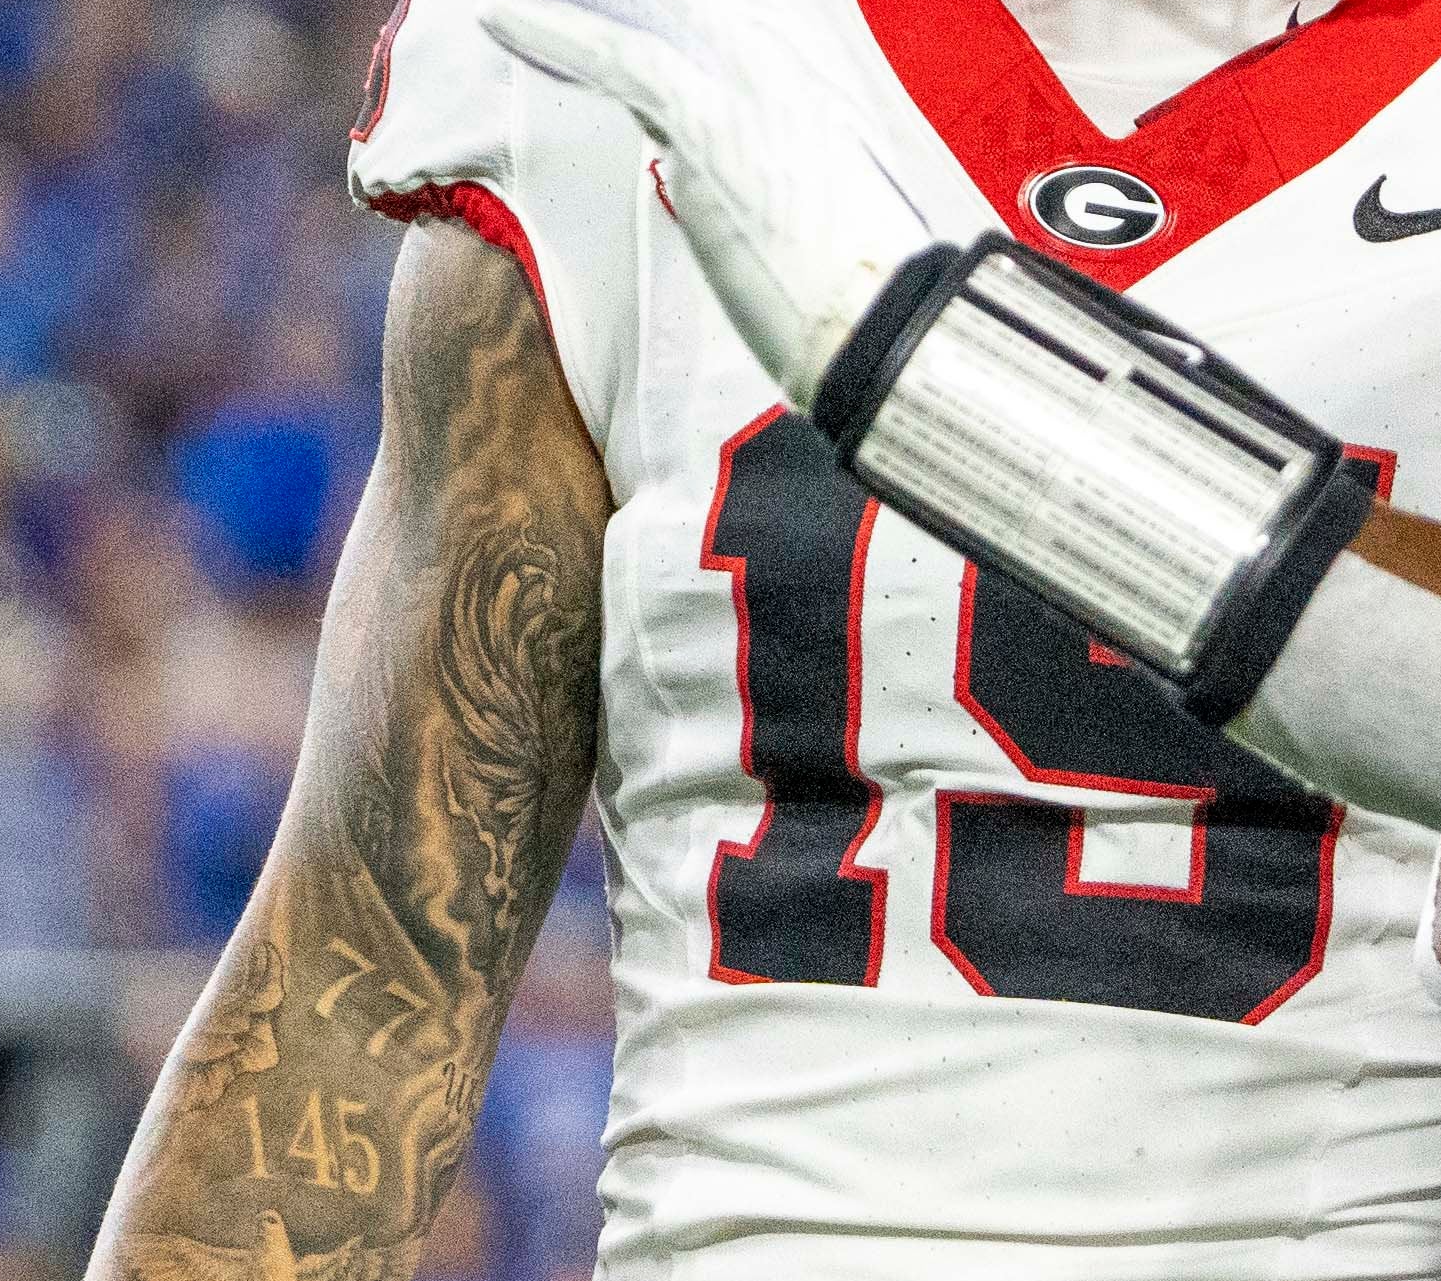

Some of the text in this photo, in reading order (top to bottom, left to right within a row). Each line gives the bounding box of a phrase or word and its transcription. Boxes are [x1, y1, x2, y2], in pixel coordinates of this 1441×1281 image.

[1031, 167, 1162, 246] G
[700, 402, 1398, 1026] 15
[242, 1090, 380, 1196] 145
